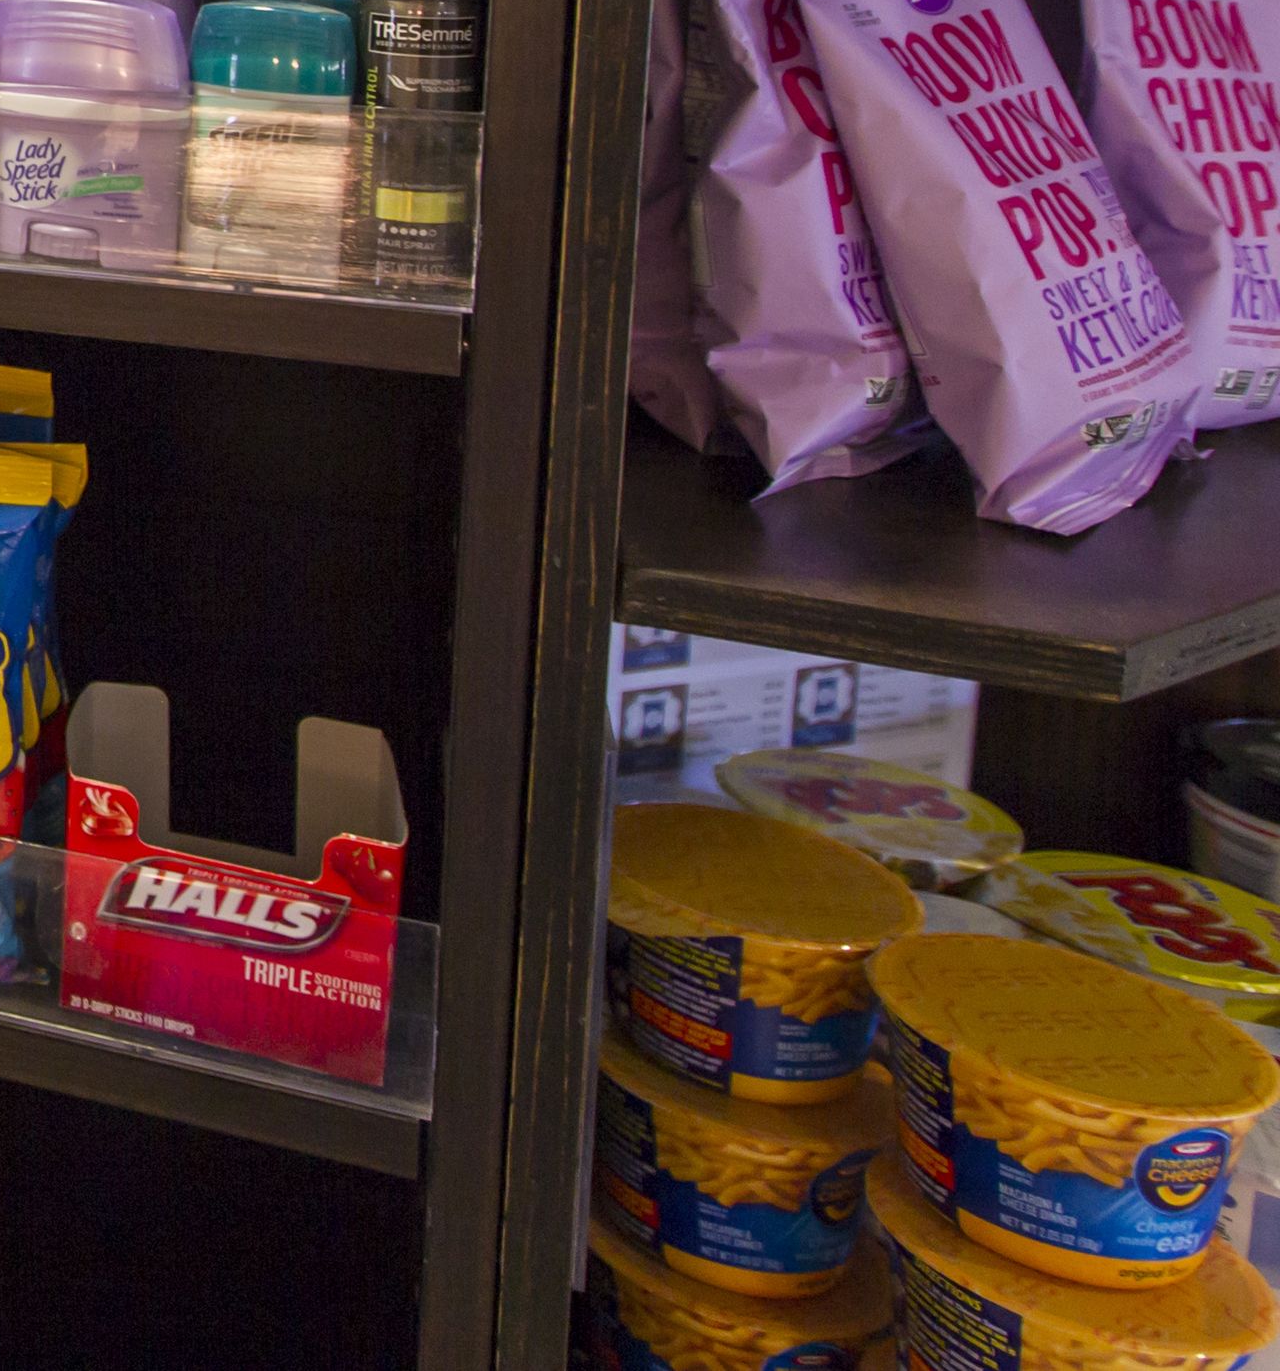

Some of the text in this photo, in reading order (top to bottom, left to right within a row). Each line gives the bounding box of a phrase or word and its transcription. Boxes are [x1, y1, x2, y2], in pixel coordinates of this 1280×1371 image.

[373, 19, 473, 43] TRESemmé
[878, 8, 1025, 109] BOOM
[15, 136, 63, 163] Lady
[359, 65, 379, 216] EXTRA FIRM CONTROL
[945, 84, 1097, 189] CHICKA
[0, 156, 66, 186] Speed
[9, 180, 58, 203] Stick
[376, 237, 438, 251] HAIR SPRAY
[996, 181, 1118, 282] POP.
[1041, 259, 1133, 321] SWEET &
[125, 865, 324, 941] HALLS
[241, 954, 313, 995] TRIPLE
[313, 972, 383, 999] SOOTHING
[312, 987, 382, 1012] ACTION
